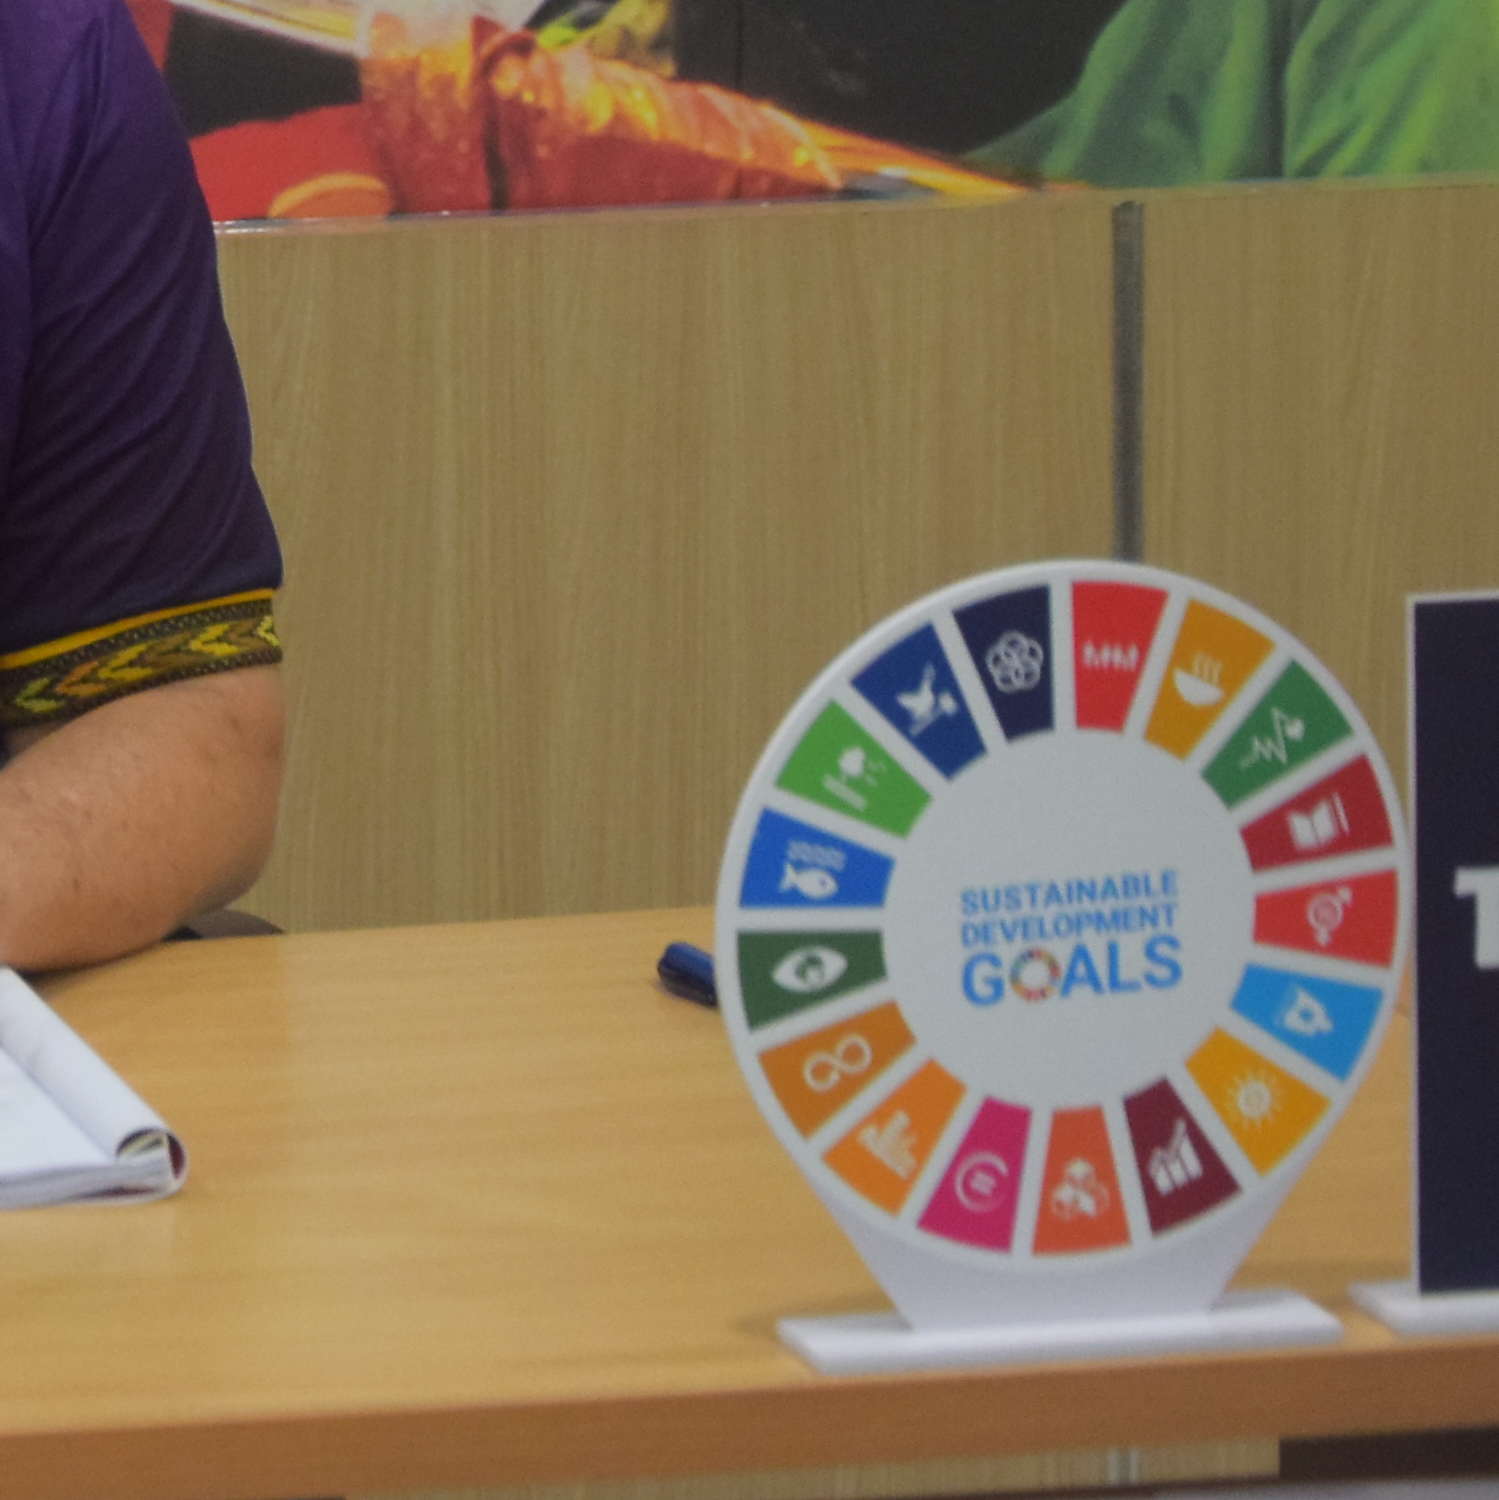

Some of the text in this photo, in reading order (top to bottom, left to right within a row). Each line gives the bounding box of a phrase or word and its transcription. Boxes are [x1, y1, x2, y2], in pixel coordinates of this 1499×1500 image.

[960, 869, 1177, 917] SUSTAINABLE
[960, 902, 1178, 948] DEVELOPMENT
[961, 933, 1184, 1007] GOALS
